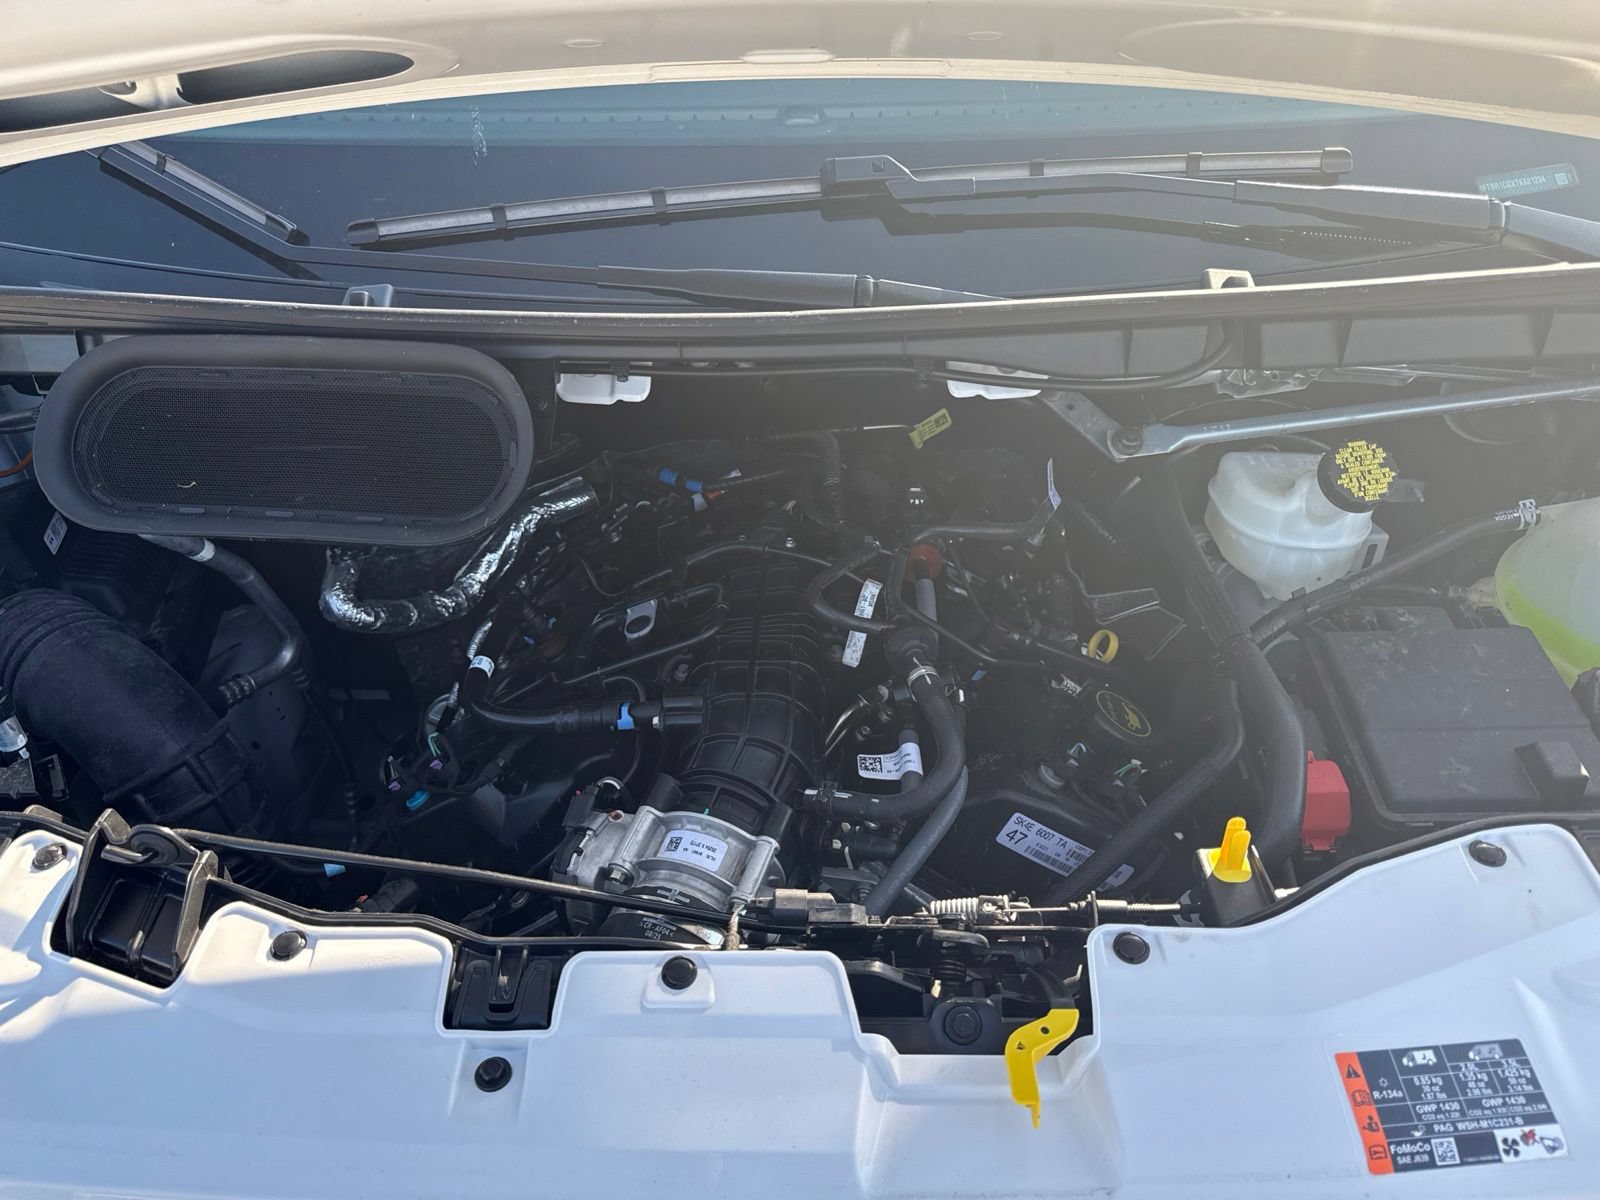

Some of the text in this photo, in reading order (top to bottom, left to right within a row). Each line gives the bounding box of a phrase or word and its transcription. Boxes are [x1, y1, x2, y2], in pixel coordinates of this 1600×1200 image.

[1005, 829, 1028, 845] 47
[1013, 816, 1035, 832] SK4E
[1035, 828, 1055, 843] 6007
[1055, 837, 1068, 849] TA
[1459, 1071, 1488, 1082] 1.35 kg
[1519, 1067, 1531, 1078] kg
[1413, 1075, 1443, 1086] 0.85 kg
[1372, 1089, 1403, 1100] R-134a
[1482, 1096, 1526, 1107] GWP 1430
[1416, 1102, 1460, 1113] GWP 1430
[1468, 1109, 1483, 1117] CO2
[1433, 1116, 1524, 1133] PAG WSH-M1C231-B
[1389, 1141, 1431, 1155] FoMoCo
[1396, 1155, 1412, 1165] SAE
